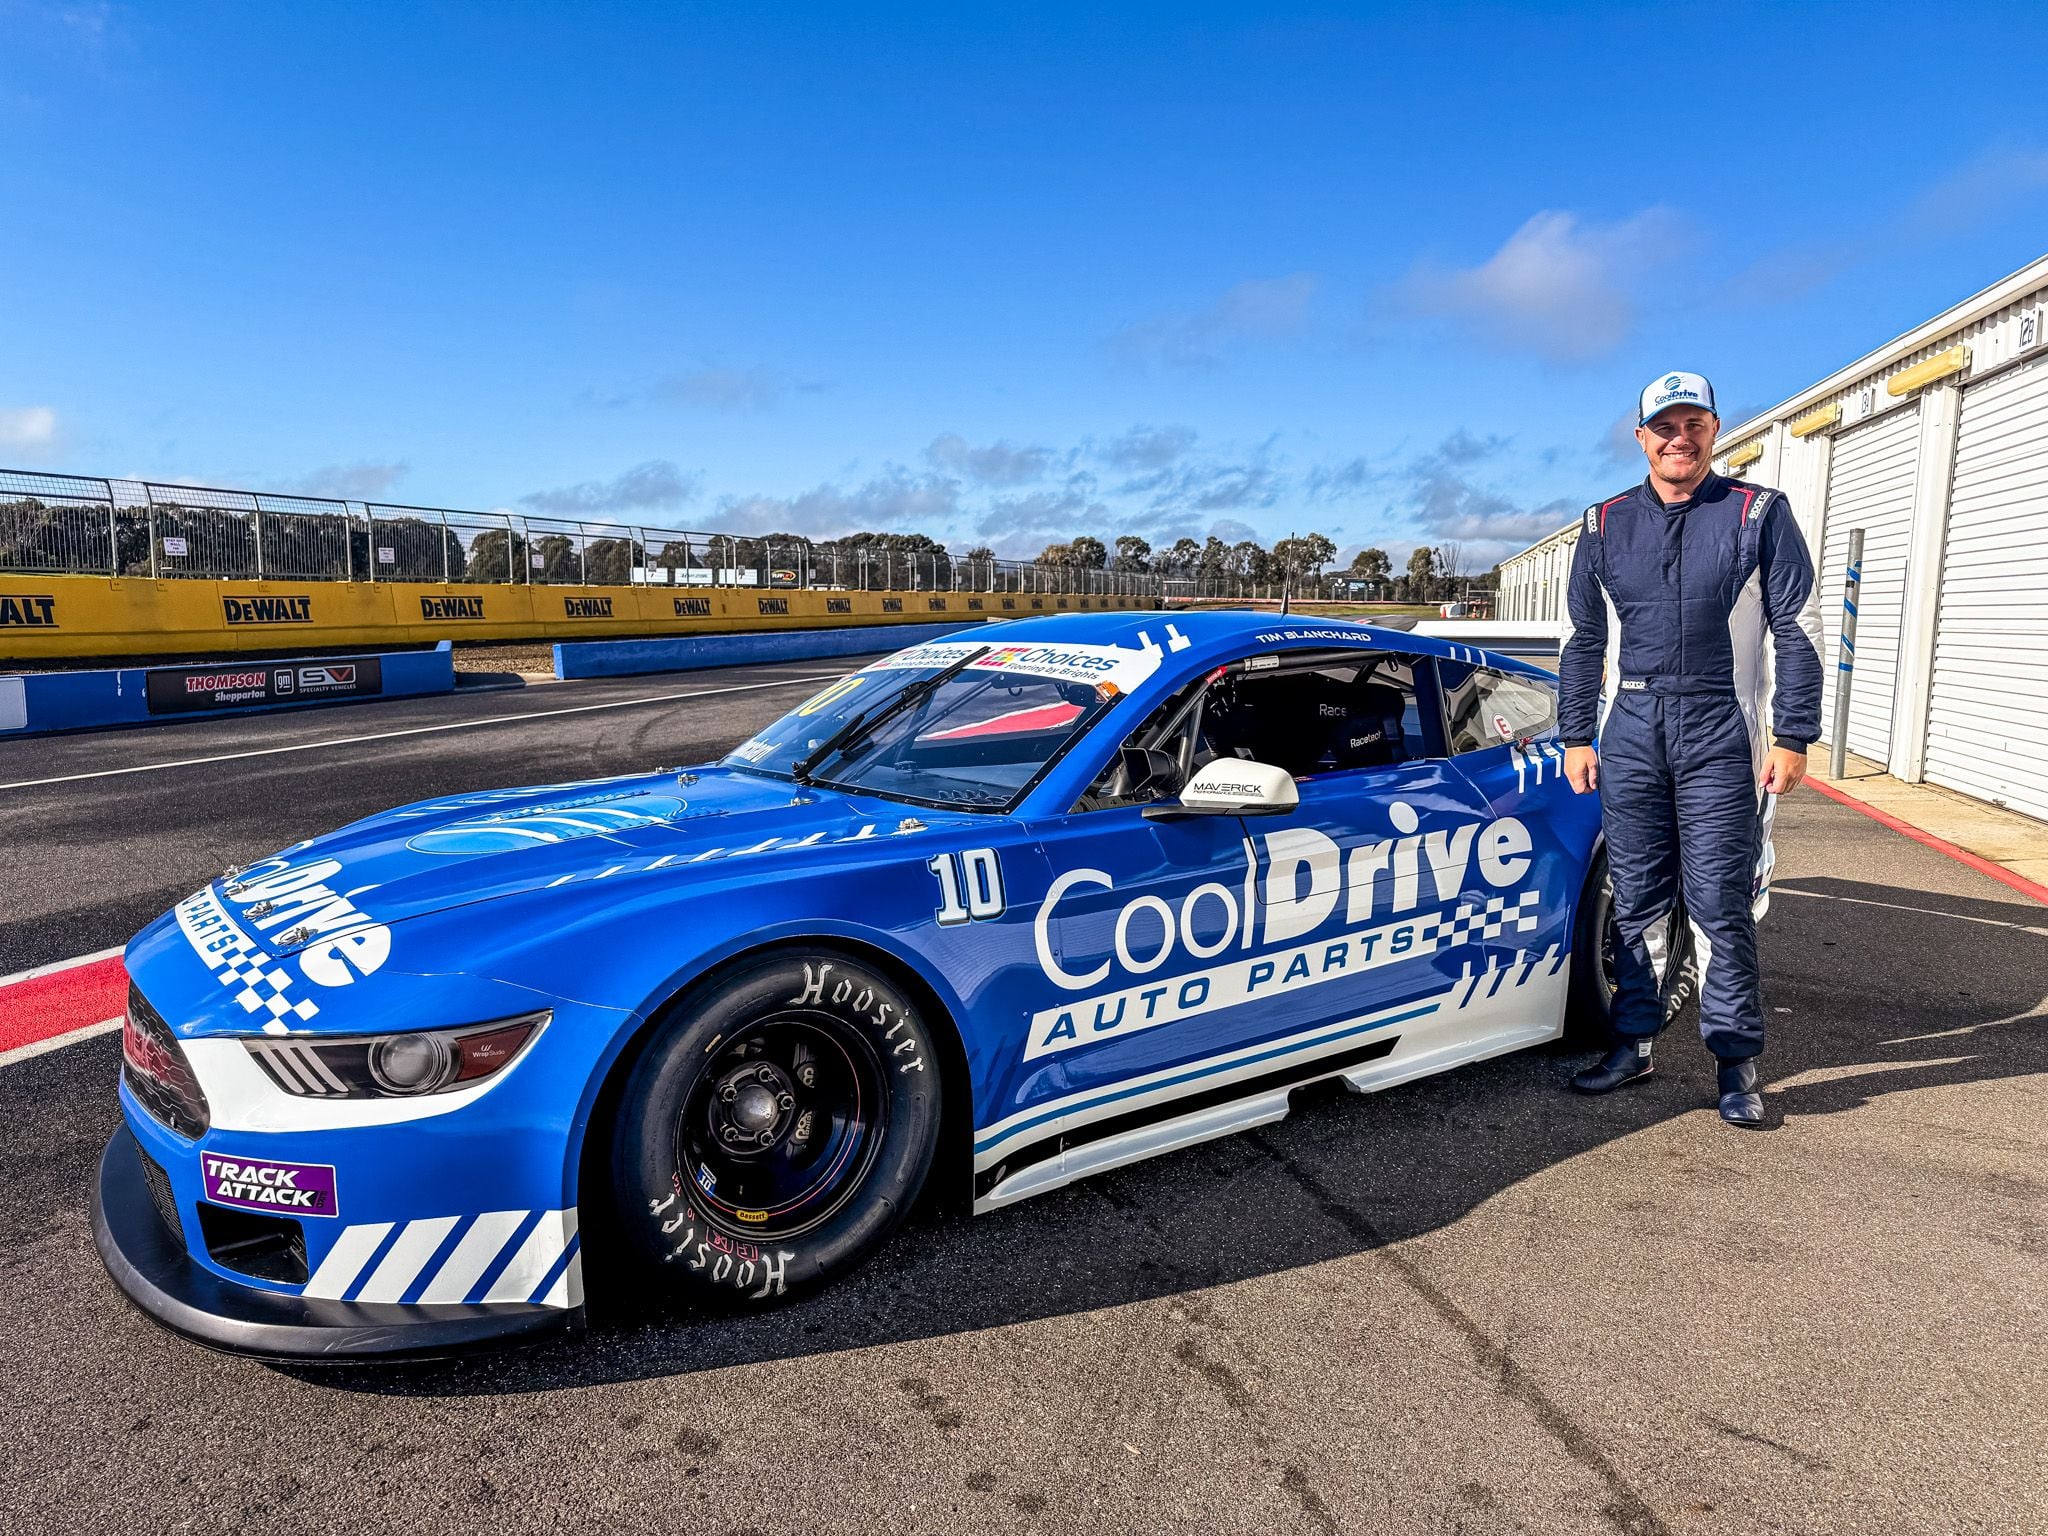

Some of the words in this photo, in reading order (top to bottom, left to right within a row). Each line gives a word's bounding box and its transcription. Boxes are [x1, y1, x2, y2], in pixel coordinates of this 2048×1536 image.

[1655, 389, 1698, 404] CoolDrive
[1749, 491, 1769, 520] sparco
[0, 599, 55, 624] ALT
[1256, 633, 1285, 644] TIM
[1284, 630, 1372, 642] BLANCHARD
[1004, 662, 1042, 674] Flooring
[1044, 666, 1060, 675] by
[1059, 667, 1100, 680] Brights
[1020, 648, 1121, 671] Choices
[186, 671, 266, 693] THOMPSON
[299, 686, 329, 694] SPECIALTY
[215, 689, 266, 703] Shepparton
[1496, 718, 1511, 735] E
[1194, 782, 1263, 794] MAVERICK
[926, 847, 1007, 929] 10
[1034, 801, 1533, 991] CoolDrive
[184, 900, 240, 953] PARTS
[1042, 976, 1211, 1048] AUTO
[1247, 924, 1417, 993] PARTS
[790, 963, 924, 1074] Hoosier
[207, 1159, 300, 1188] TRACK
[700, 1174, 712, 1191] 10
[217, 1180, 315, 1207] ATTACK
[649, 1193, 795, 1299] Hoosier
